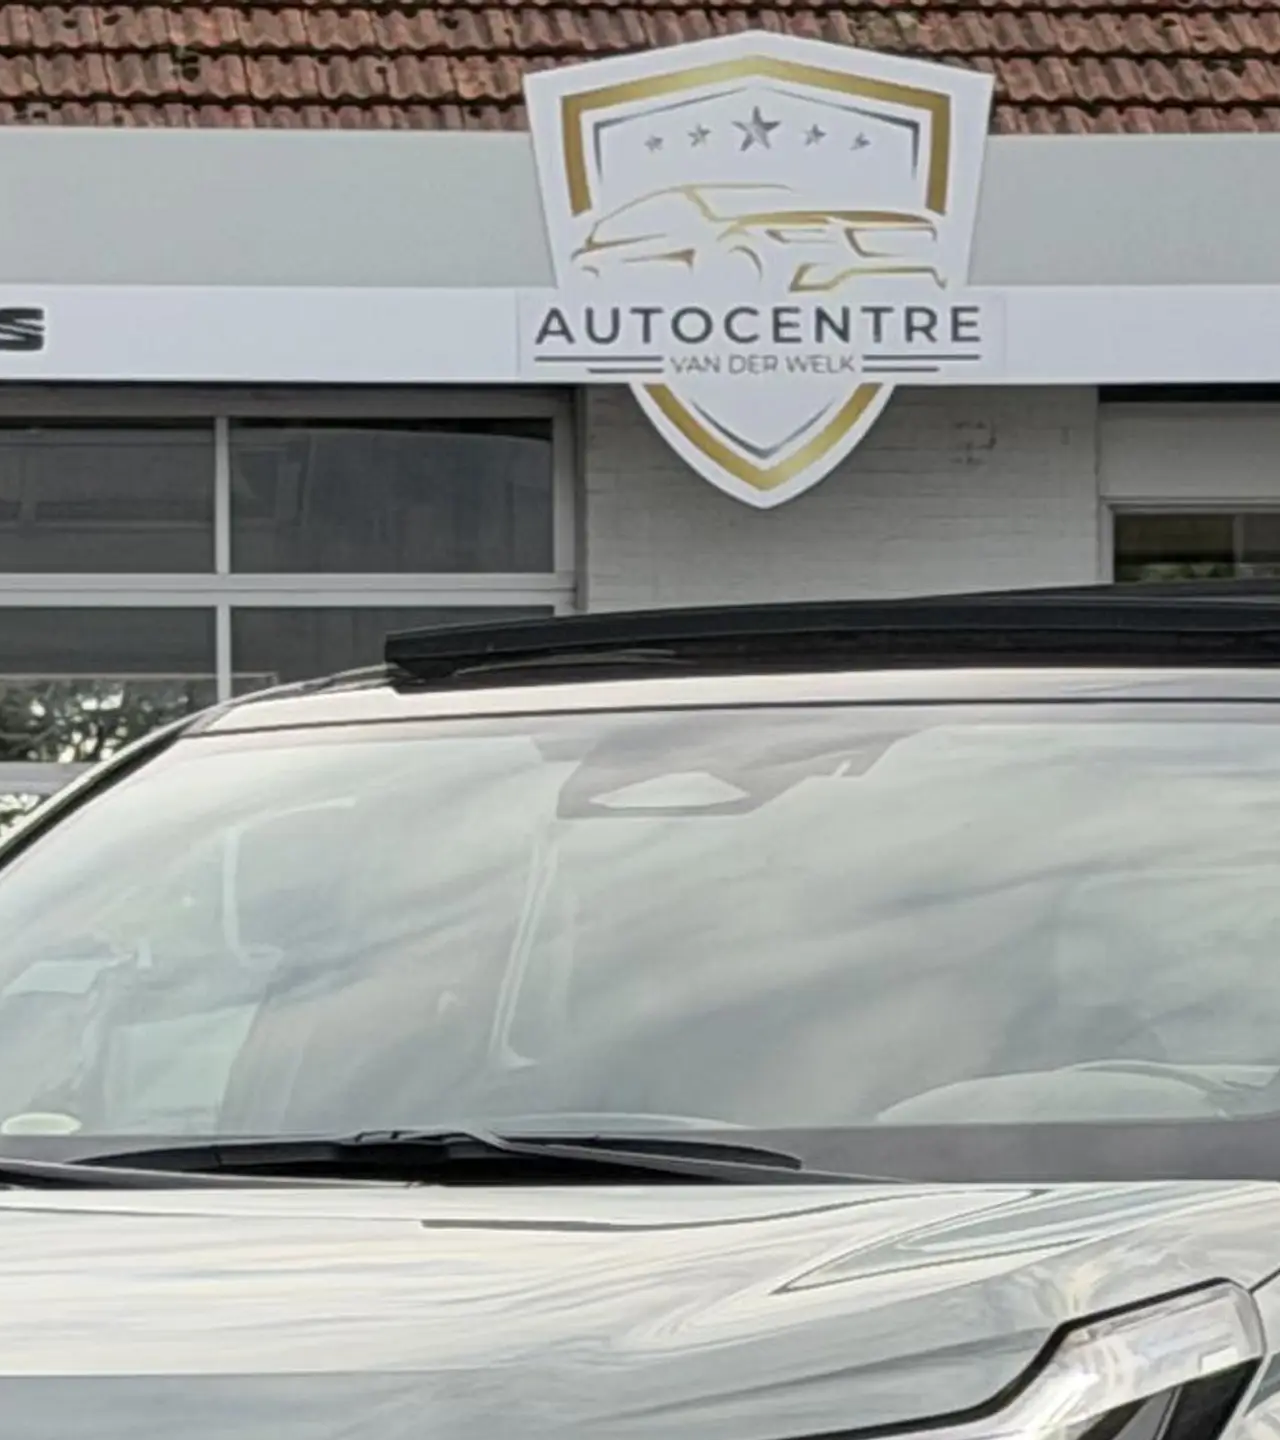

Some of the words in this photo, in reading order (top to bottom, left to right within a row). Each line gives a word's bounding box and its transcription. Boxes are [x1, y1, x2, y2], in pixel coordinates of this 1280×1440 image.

[535, 306, 982, 344] AUTOCENTRE
[670, 354, 721, 374] VAN
[727, 354, 780, 375] DER
[785, 354, 856, 374] WELK
